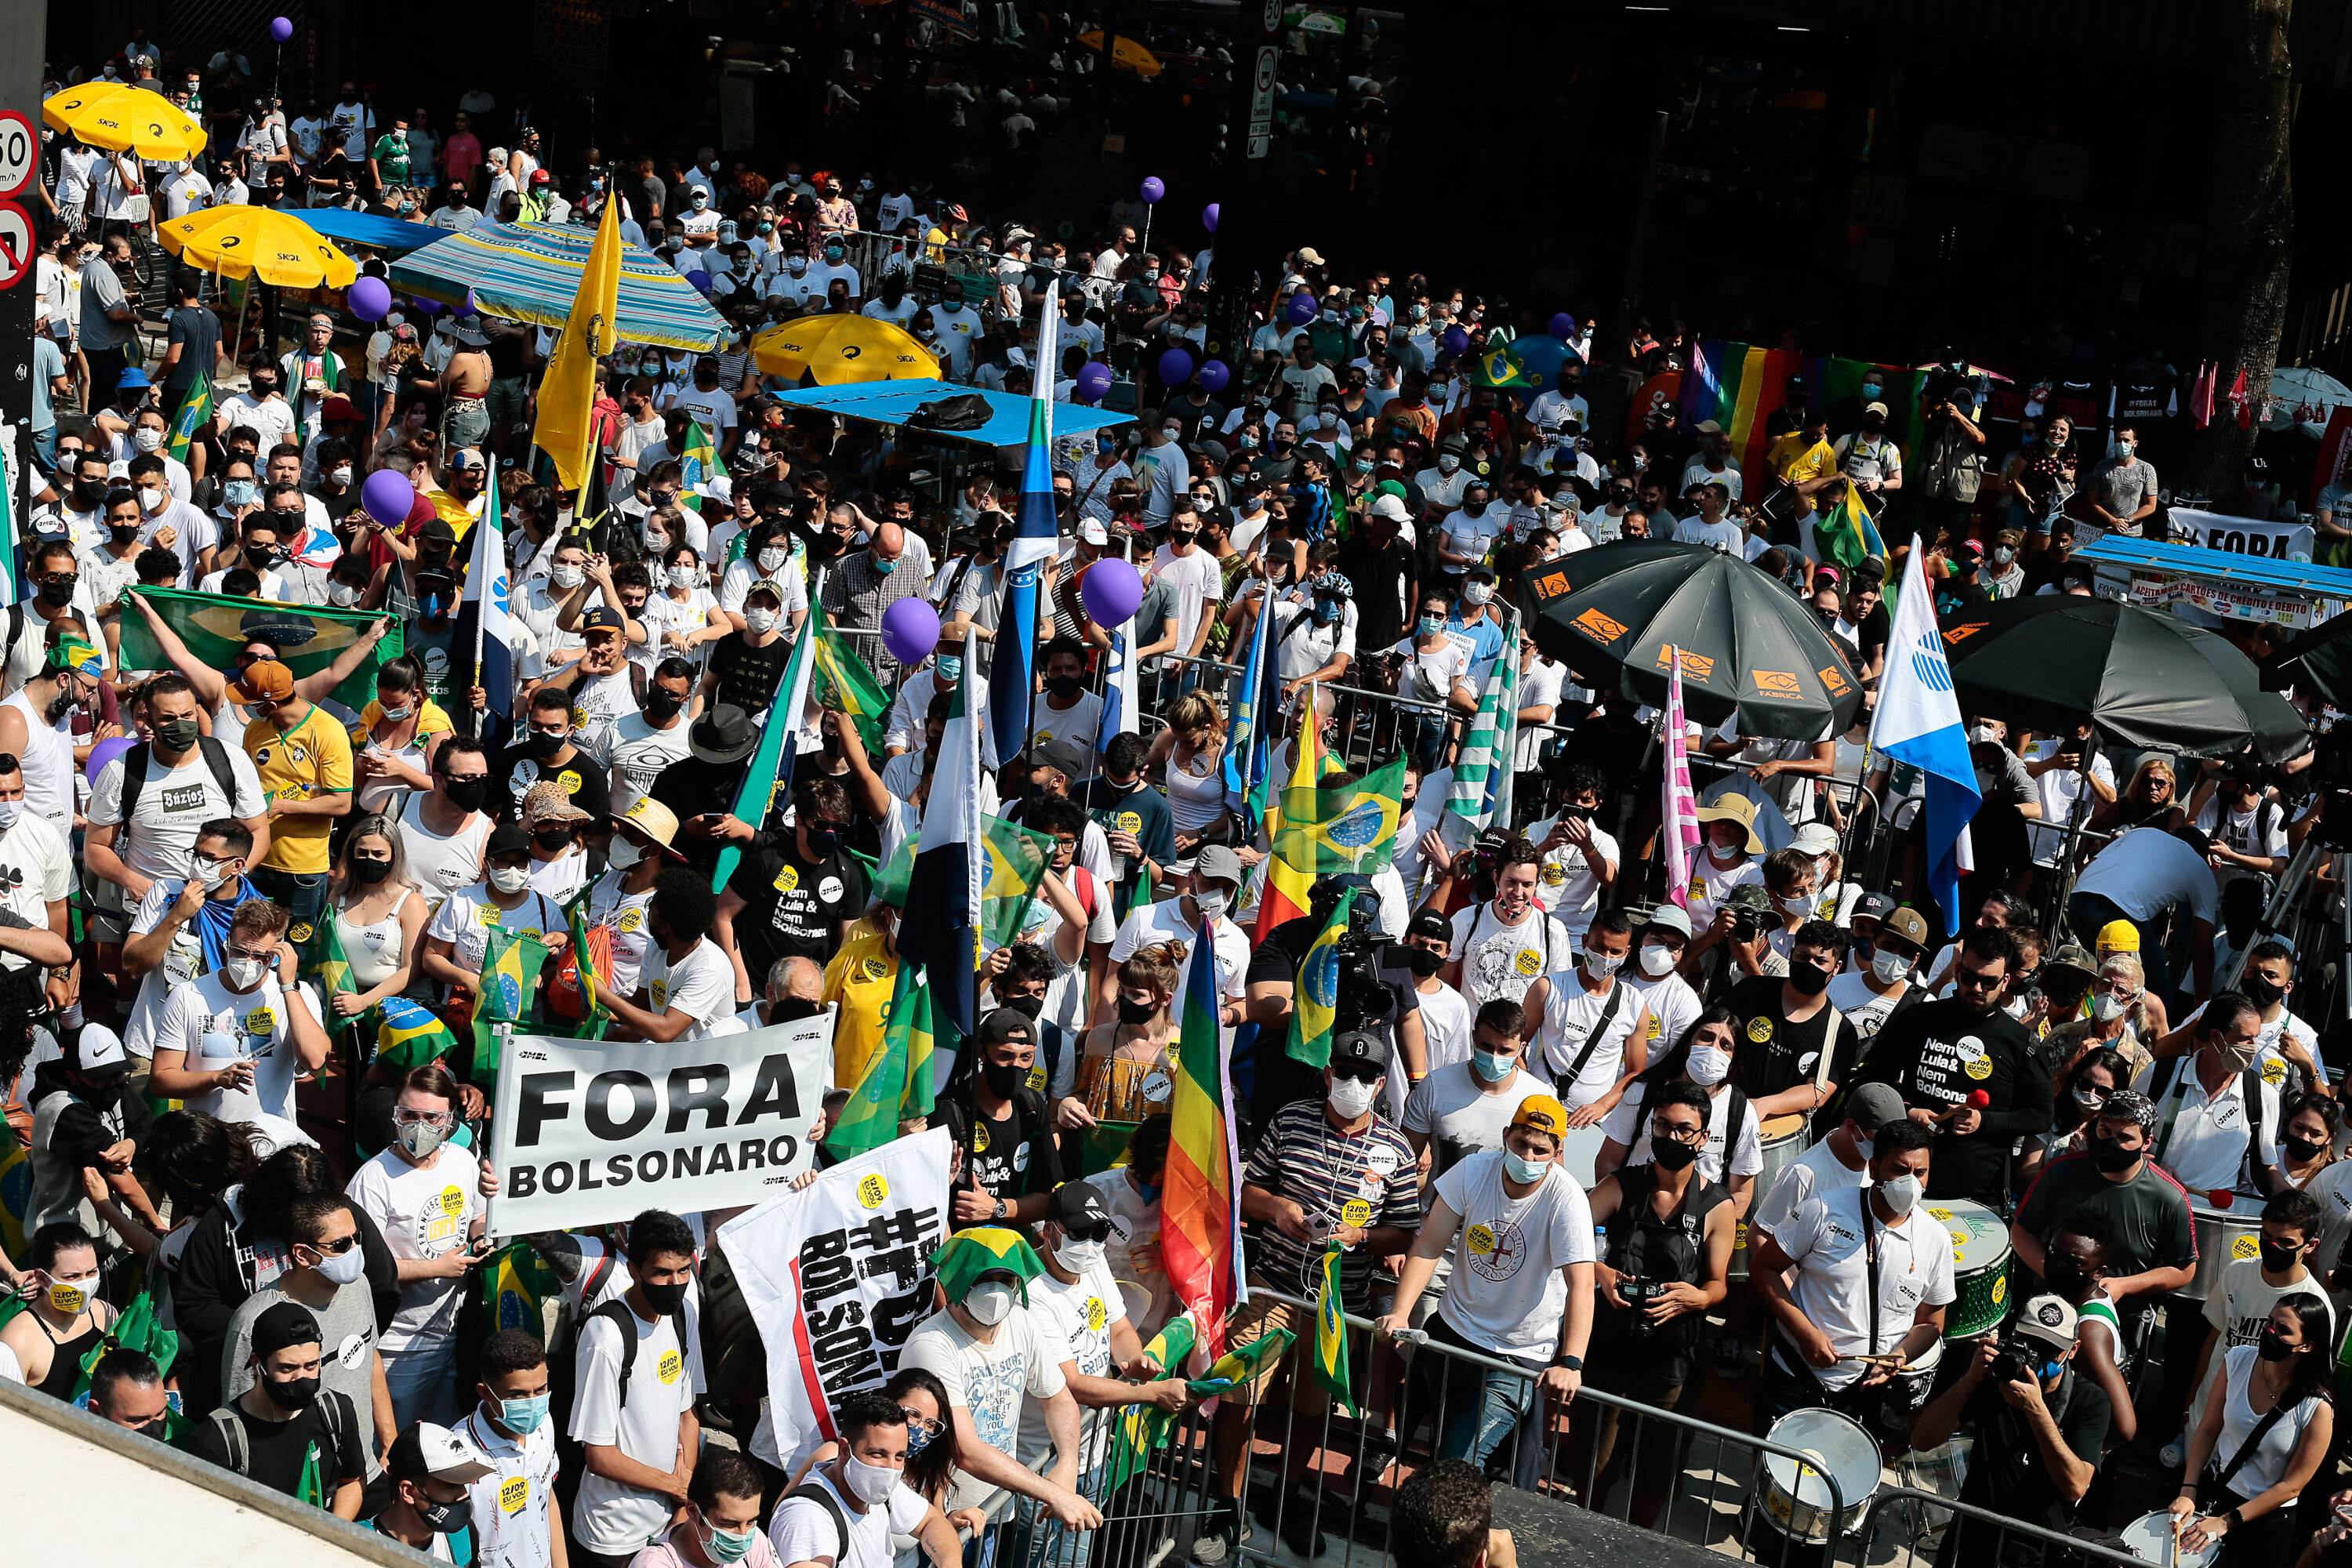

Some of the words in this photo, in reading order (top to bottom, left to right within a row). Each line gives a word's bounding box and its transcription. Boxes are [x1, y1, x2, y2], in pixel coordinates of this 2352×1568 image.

[96, 118, 119, 129] SKOL
[0, 132, 25, 167] 0
[277, 252, 302, 262] SKOL
[897, 354, 917, 363] SKOL
[2208, 528, 2290, 560] FORA
[2135, 584, 2180, 598] ACEITAMOS
[2181, 583, 2216, 599] CARTÕES
[2218, 590, 2228, 601] DE
[2230, 591, 2267, 608] CRÉDITO
[2269, 600, 2274, 608] E
[2275, 600, 2307, 615] DÉBITO
[1569, 620, 1609, 646] FÁBRICA
[1656, 661, 1709, 684] FÁRICA
[426, 681, 449, 695] idas
[1759, 690, 1805, 700] FÁBRICA
[164, 789, 204, 808] Búzios
[514, 807, 524, 821] DO
[779, 869, 796, 880] 2/09
[783, 887, 808, 900] Nem
[777, 898, 804, 912] Lula
[806, 900, 817, 913] &
[775, 909, 802, 924] Nem
[866, 957, 887, 970] 12/09
[1522, 953, 1539, 966] 12/09
[1525, 962, 1536, 971] VOU
[873, 965, 885, 975] VOU
[1754, 1019, 1772, 1033] 12/09
[1758, 1029, 1768, 1038] VOU
[1356, 1040, 1363, 1055] B
[1924, 1037, 1955, 1057] Nem
[1916, 1064, 1947, 1083] Nem
[1916, 1077, 1969, 1104] Bolsona
[514, 1053, 801, 1148] FORA
[506, 1134, 798, 1198] BOLSONARO
[982, 1170, 1003, 1184] ula
[1001, 1168, 1012, 1181] &
[864, 1181, 871, 1190] EU
[869, 1177, 884, 1201] 12/09
[442, 1192, 462, 1202] 12/09
[867, 1189, 877, 1205] VOU
[1346, 1204, 1368, 1213] 12/09
[416, 1198, 440, 1246] FRANCISC
[1469, 1233, 1478, 1243] EU
[1478, 1238, 1490, 1249] VOU
[1472, 1227, 1493, 1243] 12/09
[2238, 1239, 2257, 1253] 12/09
[2241, 1247, 2255, 1258] VOU
[54, 1290, 78, 1299] 12/09
[659, 1356, 677, 1370] 12/09
[668, 1362, 678, 1372] VOU
[997, 1388, 1011, 1398] THE
[985, 1420, 1004, 1430] YOU
[502, 1481, 525, 1497] 12/09
[503, 1495, 511, 1504] EU
[512, 1490, 525, 1500] VOU
